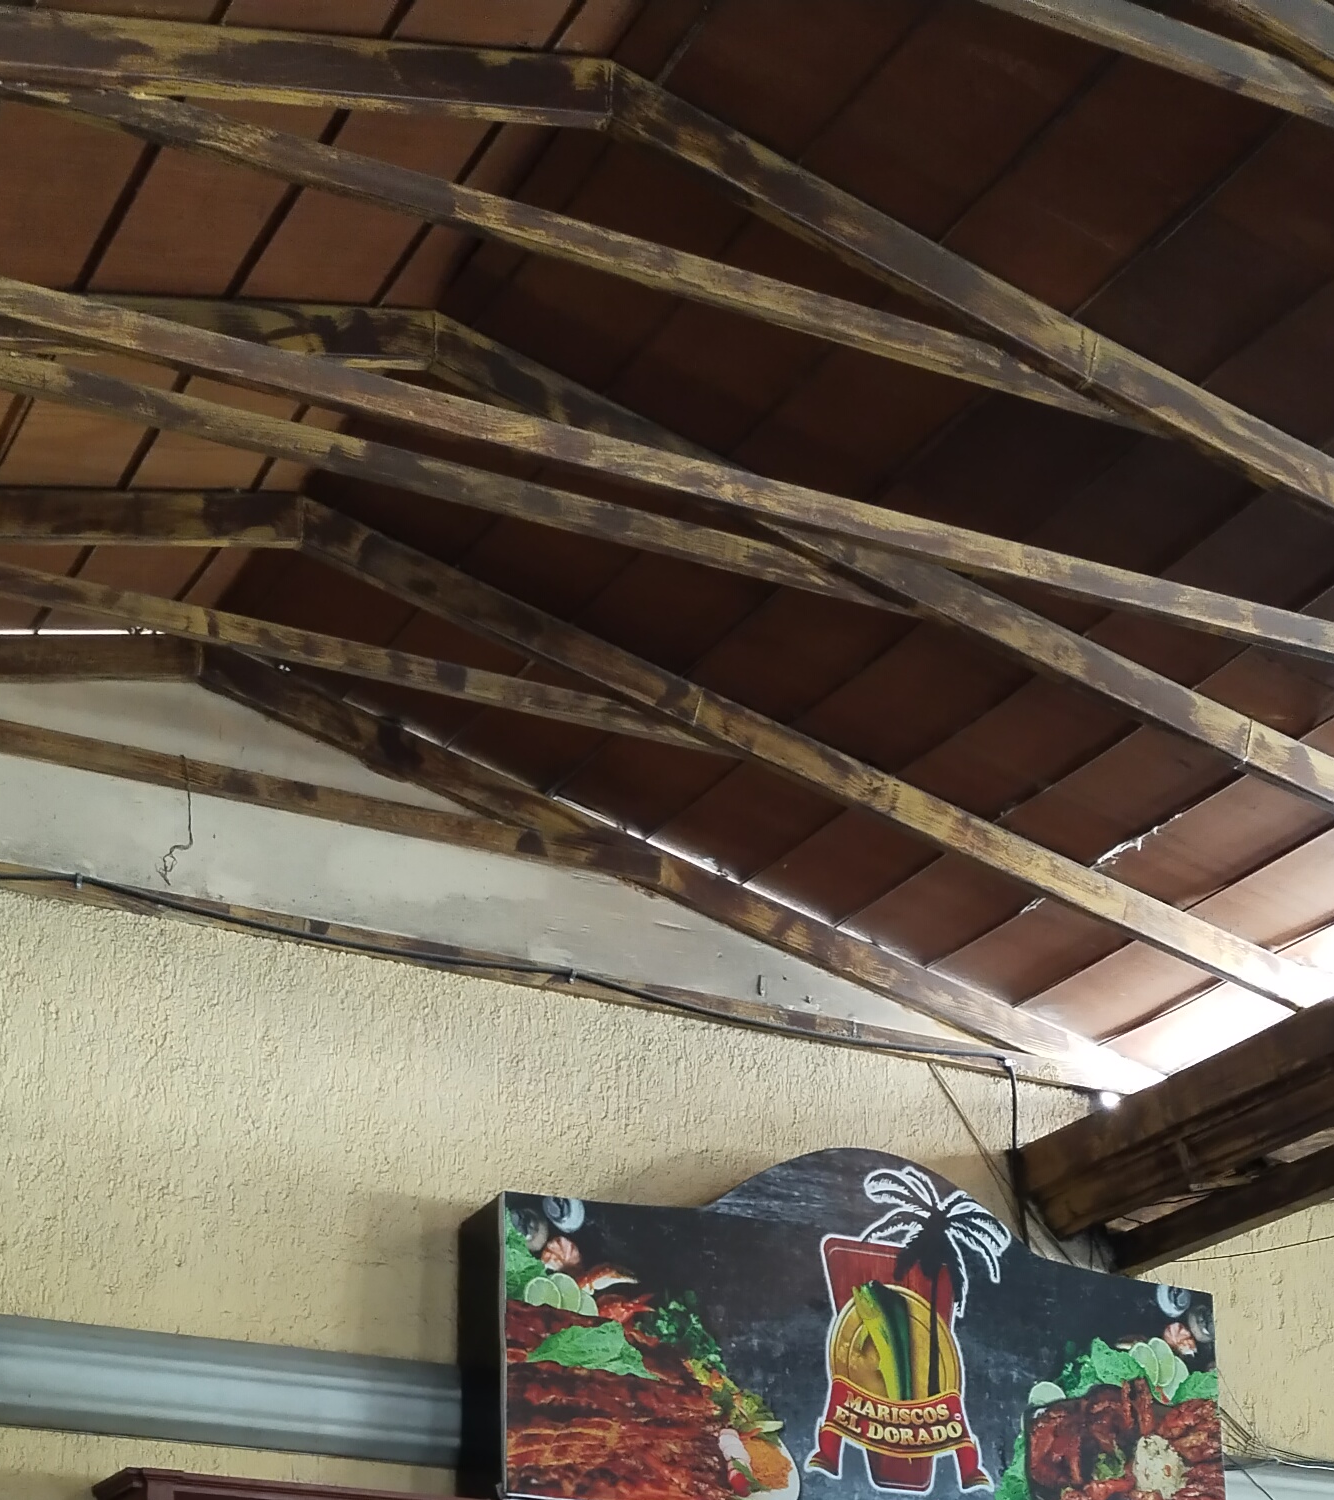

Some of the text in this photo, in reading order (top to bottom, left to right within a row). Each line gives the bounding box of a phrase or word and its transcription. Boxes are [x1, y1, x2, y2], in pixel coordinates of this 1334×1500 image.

[833, 1405, 963, 1445] EL DORADO
[844, 1391, 950, 1425] MARISCOS
